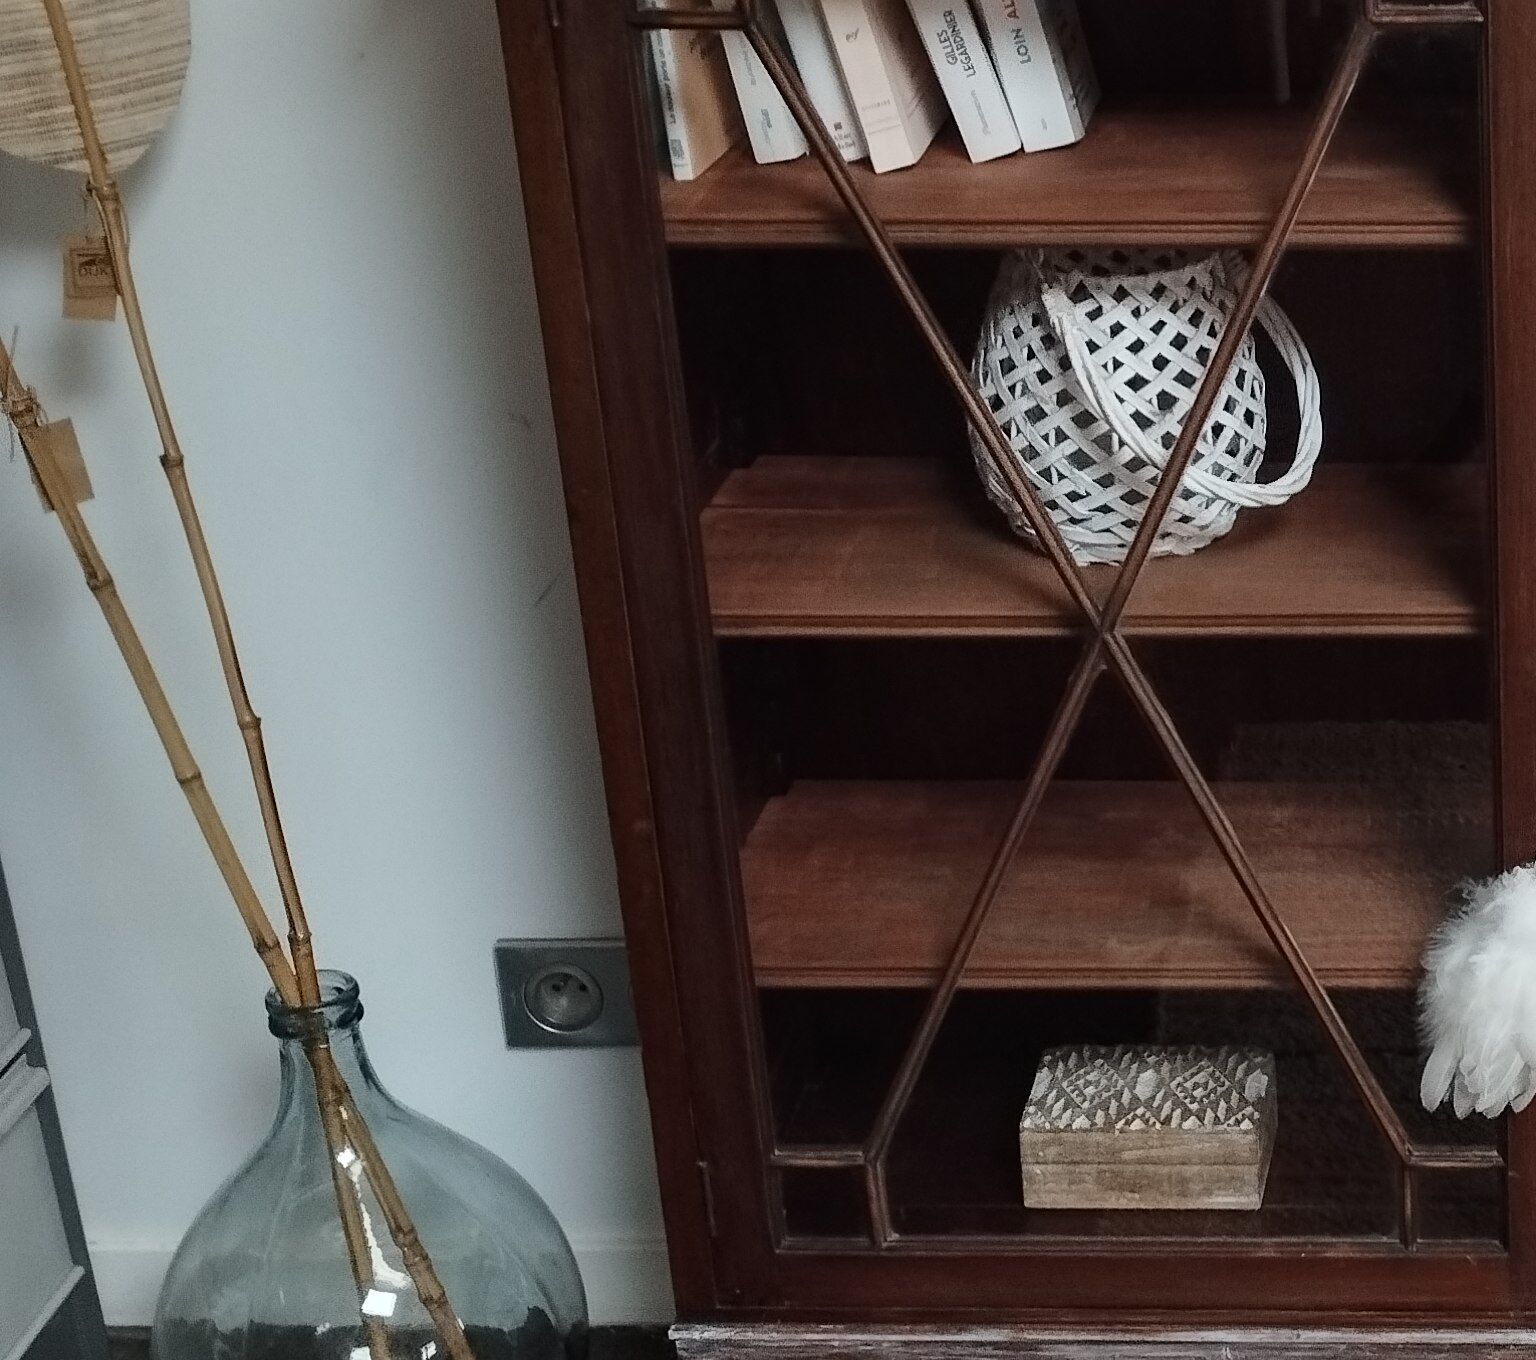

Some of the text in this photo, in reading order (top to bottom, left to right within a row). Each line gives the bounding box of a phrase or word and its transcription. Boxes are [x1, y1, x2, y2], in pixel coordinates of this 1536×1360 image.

[937, 29, 959, 66] GILLES
[942, 9, 977, 78] LEGARDINIER
[1010, 27, 1032, 65] LOIN
